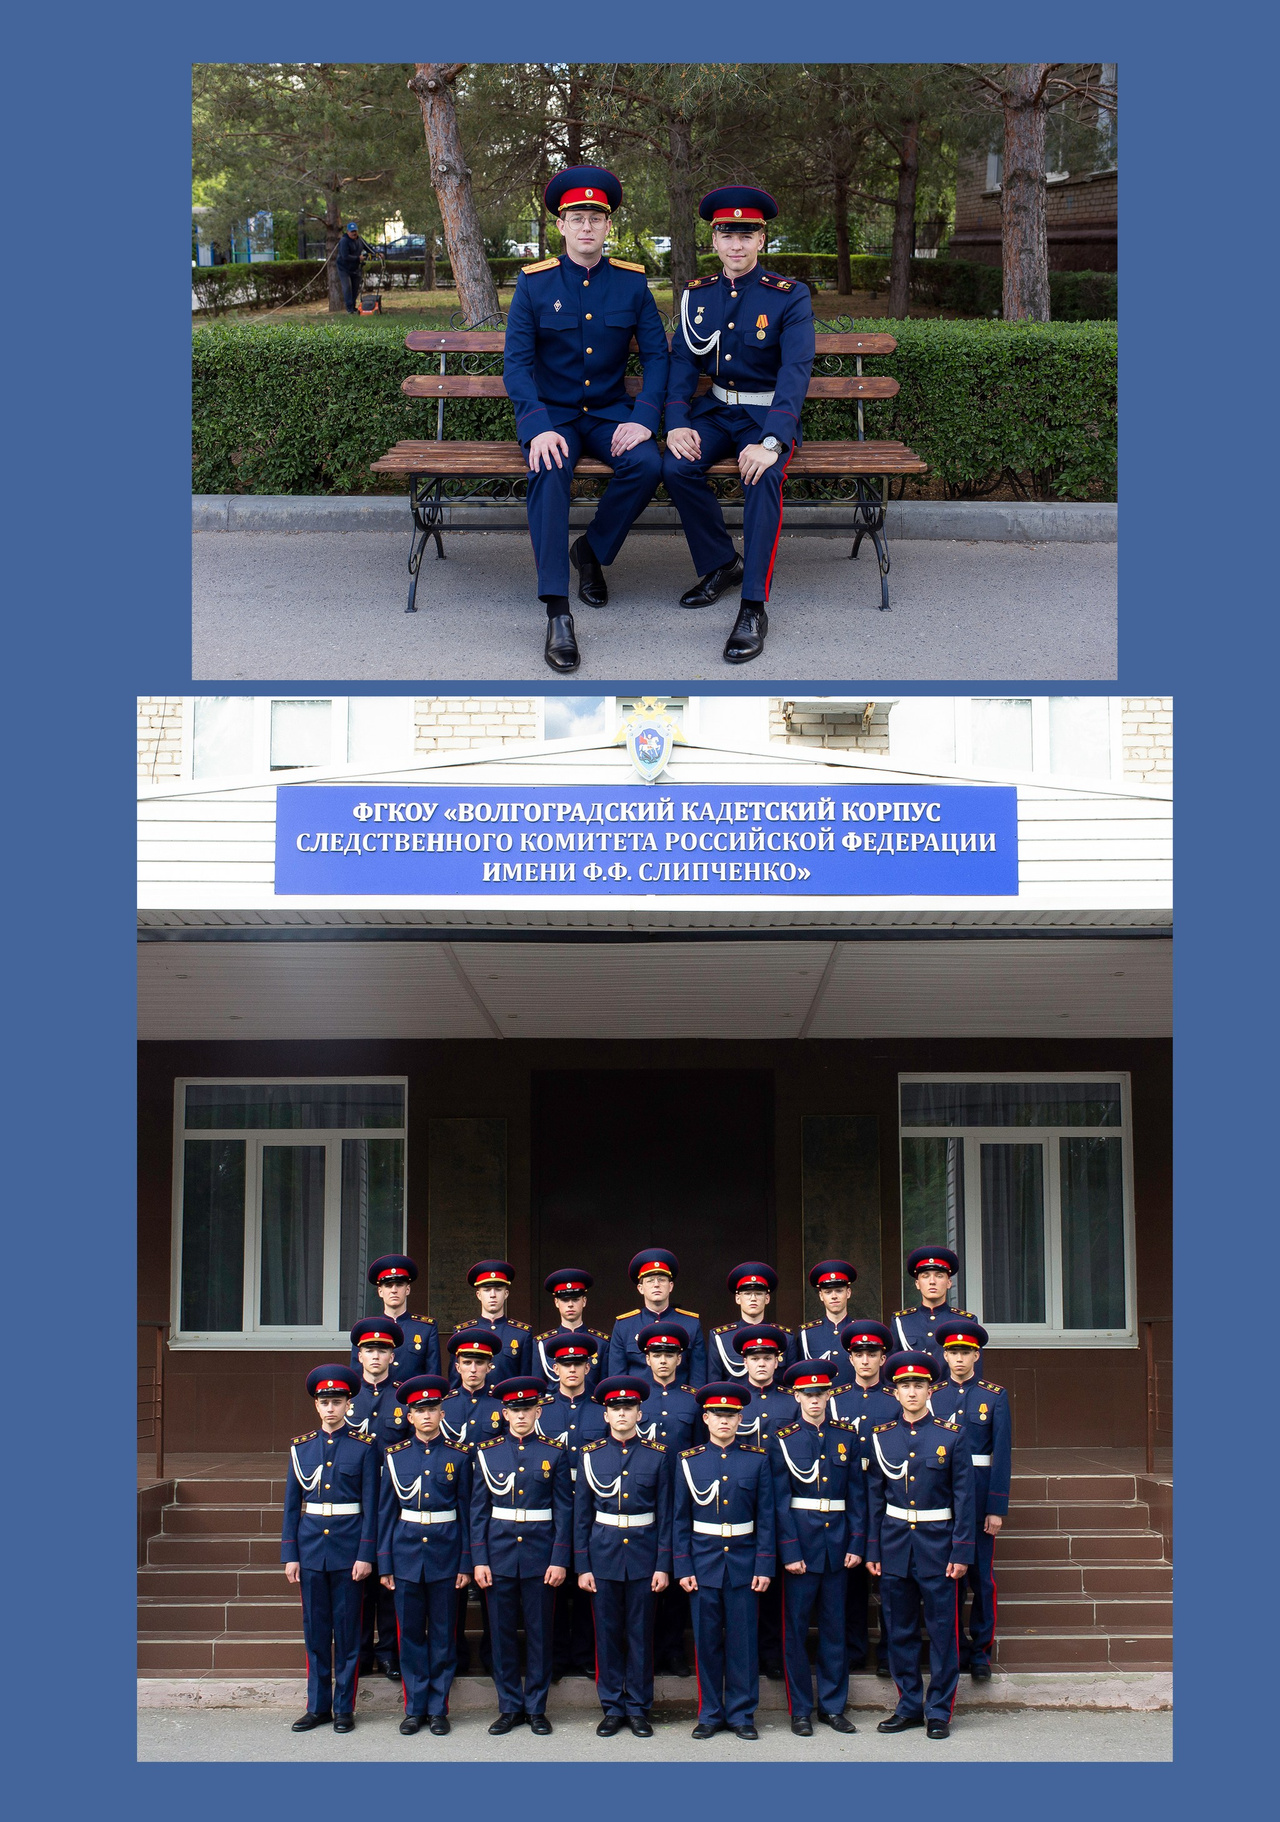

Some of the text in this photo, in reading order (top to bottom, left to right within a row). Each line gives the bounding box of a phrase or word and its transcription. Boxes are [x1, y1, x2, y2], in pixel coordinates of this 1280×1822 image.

[352, 797, 941, 826] ФГКОУ «ВОЛГОГРАДСКИЙ КАДЕТСКИЙ КОРПУС
[296, 827, 996, 856] СЛЕДСТВЕННОГО КОМИТЕТА РОССИЙСКОЙ ФЕДЕРАЦИИ
[482, 861, 811, 882] ИМЕНИ Ф.Ф. СЛИПЧЕНКО»
